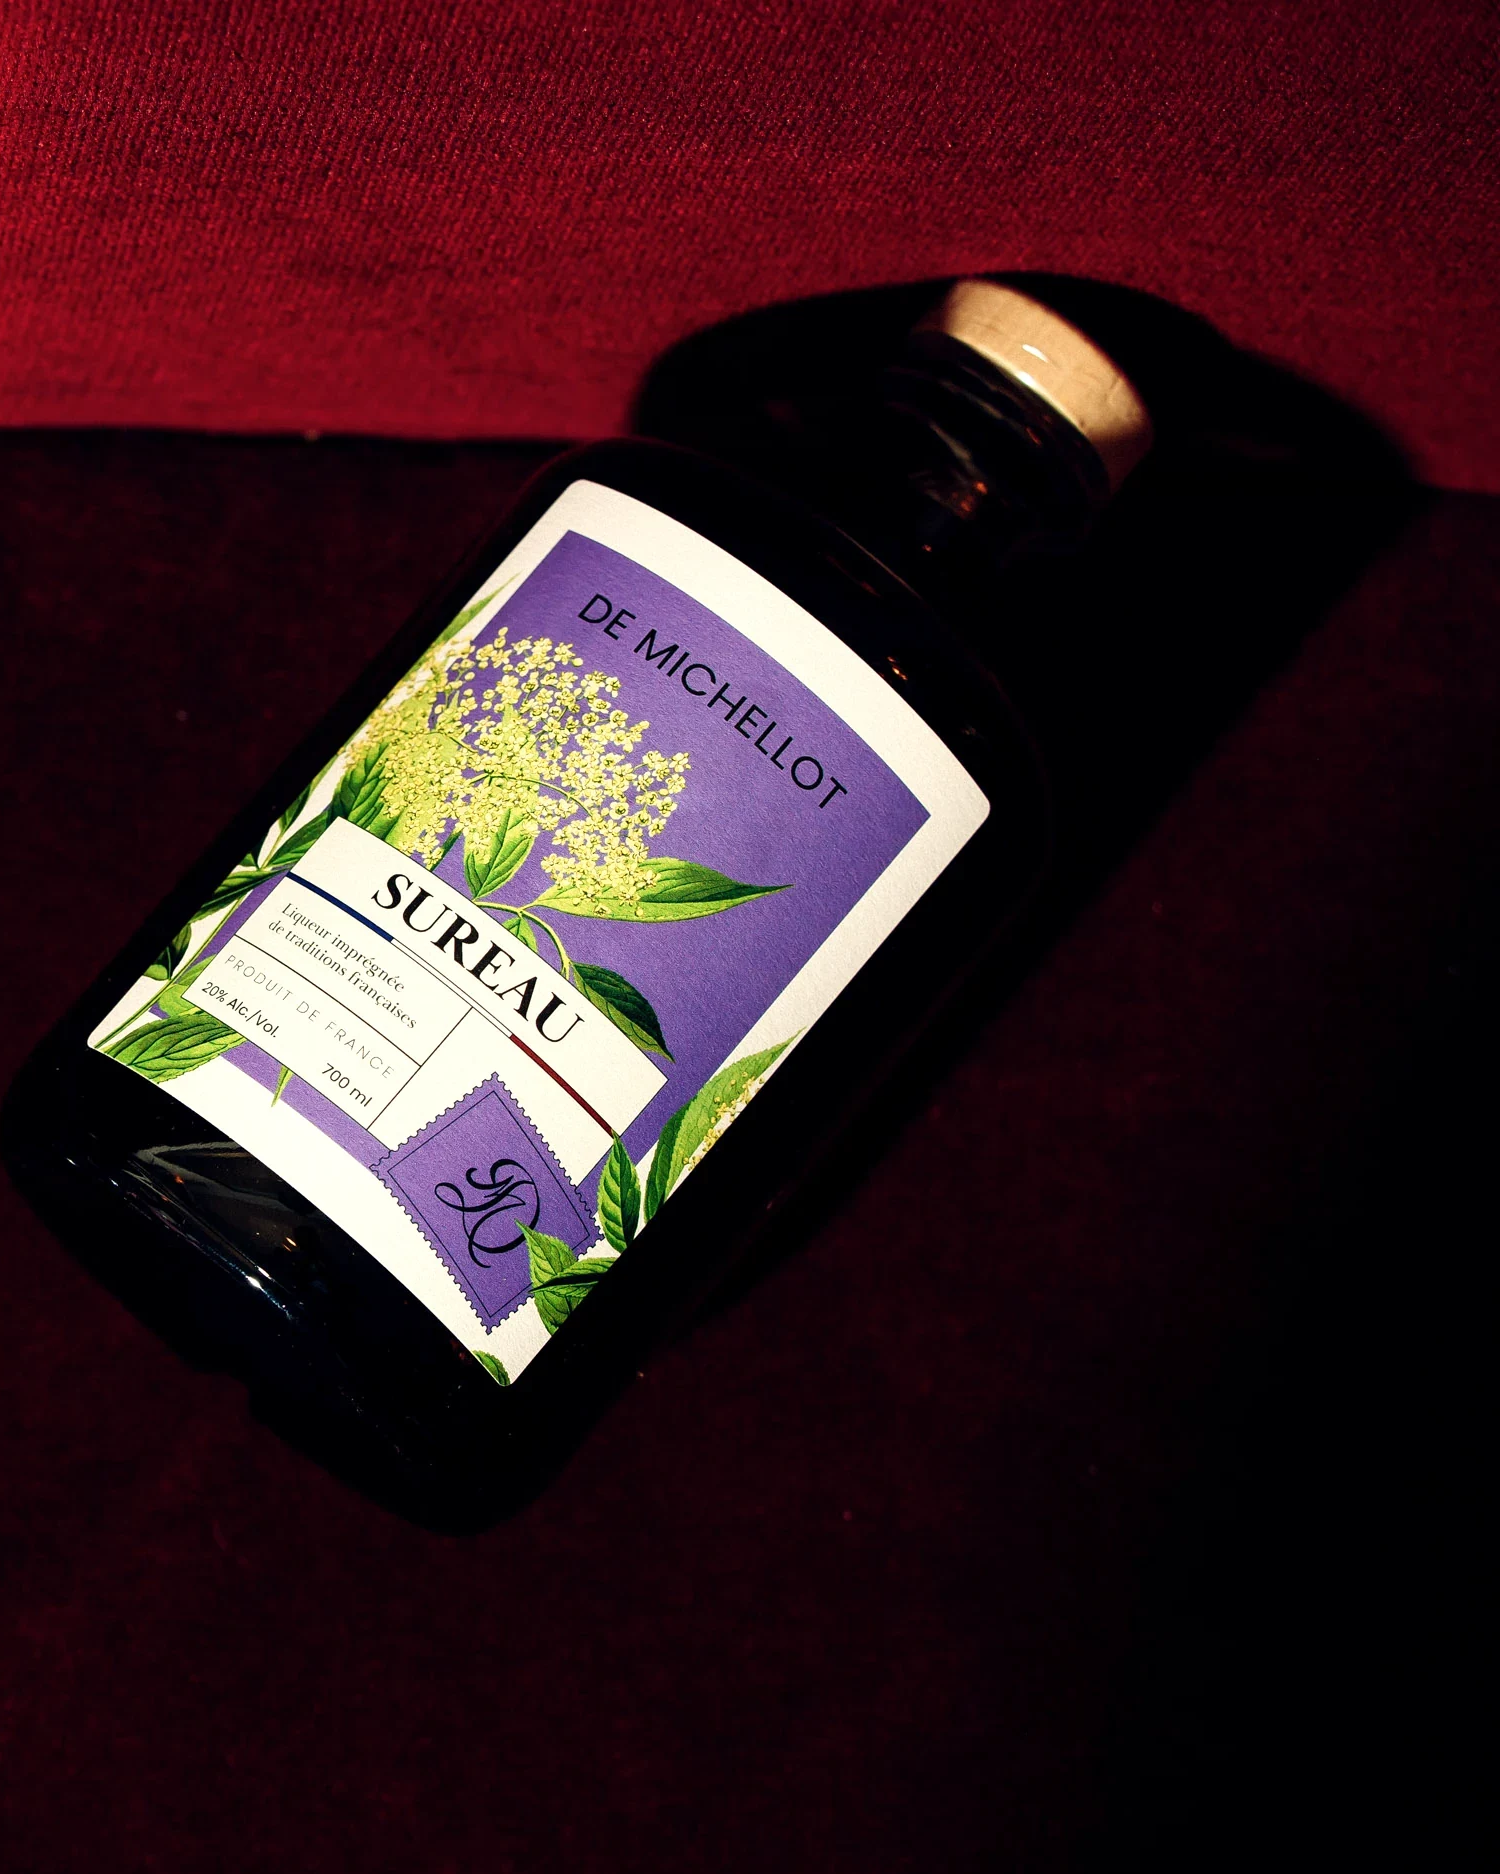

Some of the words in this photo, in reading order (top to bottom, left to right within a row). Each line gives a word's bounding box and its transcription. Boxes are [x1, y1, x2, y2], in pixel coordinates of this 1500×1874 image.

[577, 593, 637, 641] DE
[632, 628, 849, 810] MICHELLOT
[268, 920, 285, 935] de
[284, 930, 348, 976] traditions
[347, 971, 417, 1029] françaises
[281, 902, 332, 939] Liqueur
[331, 934, 405, 993] imprégnée
[370, 873, 586, 1043] SUREAU
[201, 981, 229, 1003] 20%
[226, 998, 280, 1038] Alc./Vol.
[224, 954, 293, 1001] PRODUIT
[295, 1000, 321, 1022] DE
[324, 1021, 395, 1079] FRANCE
[321, 1062, 350, 1089] 700
[349, 1088, 373, 1107] ml
